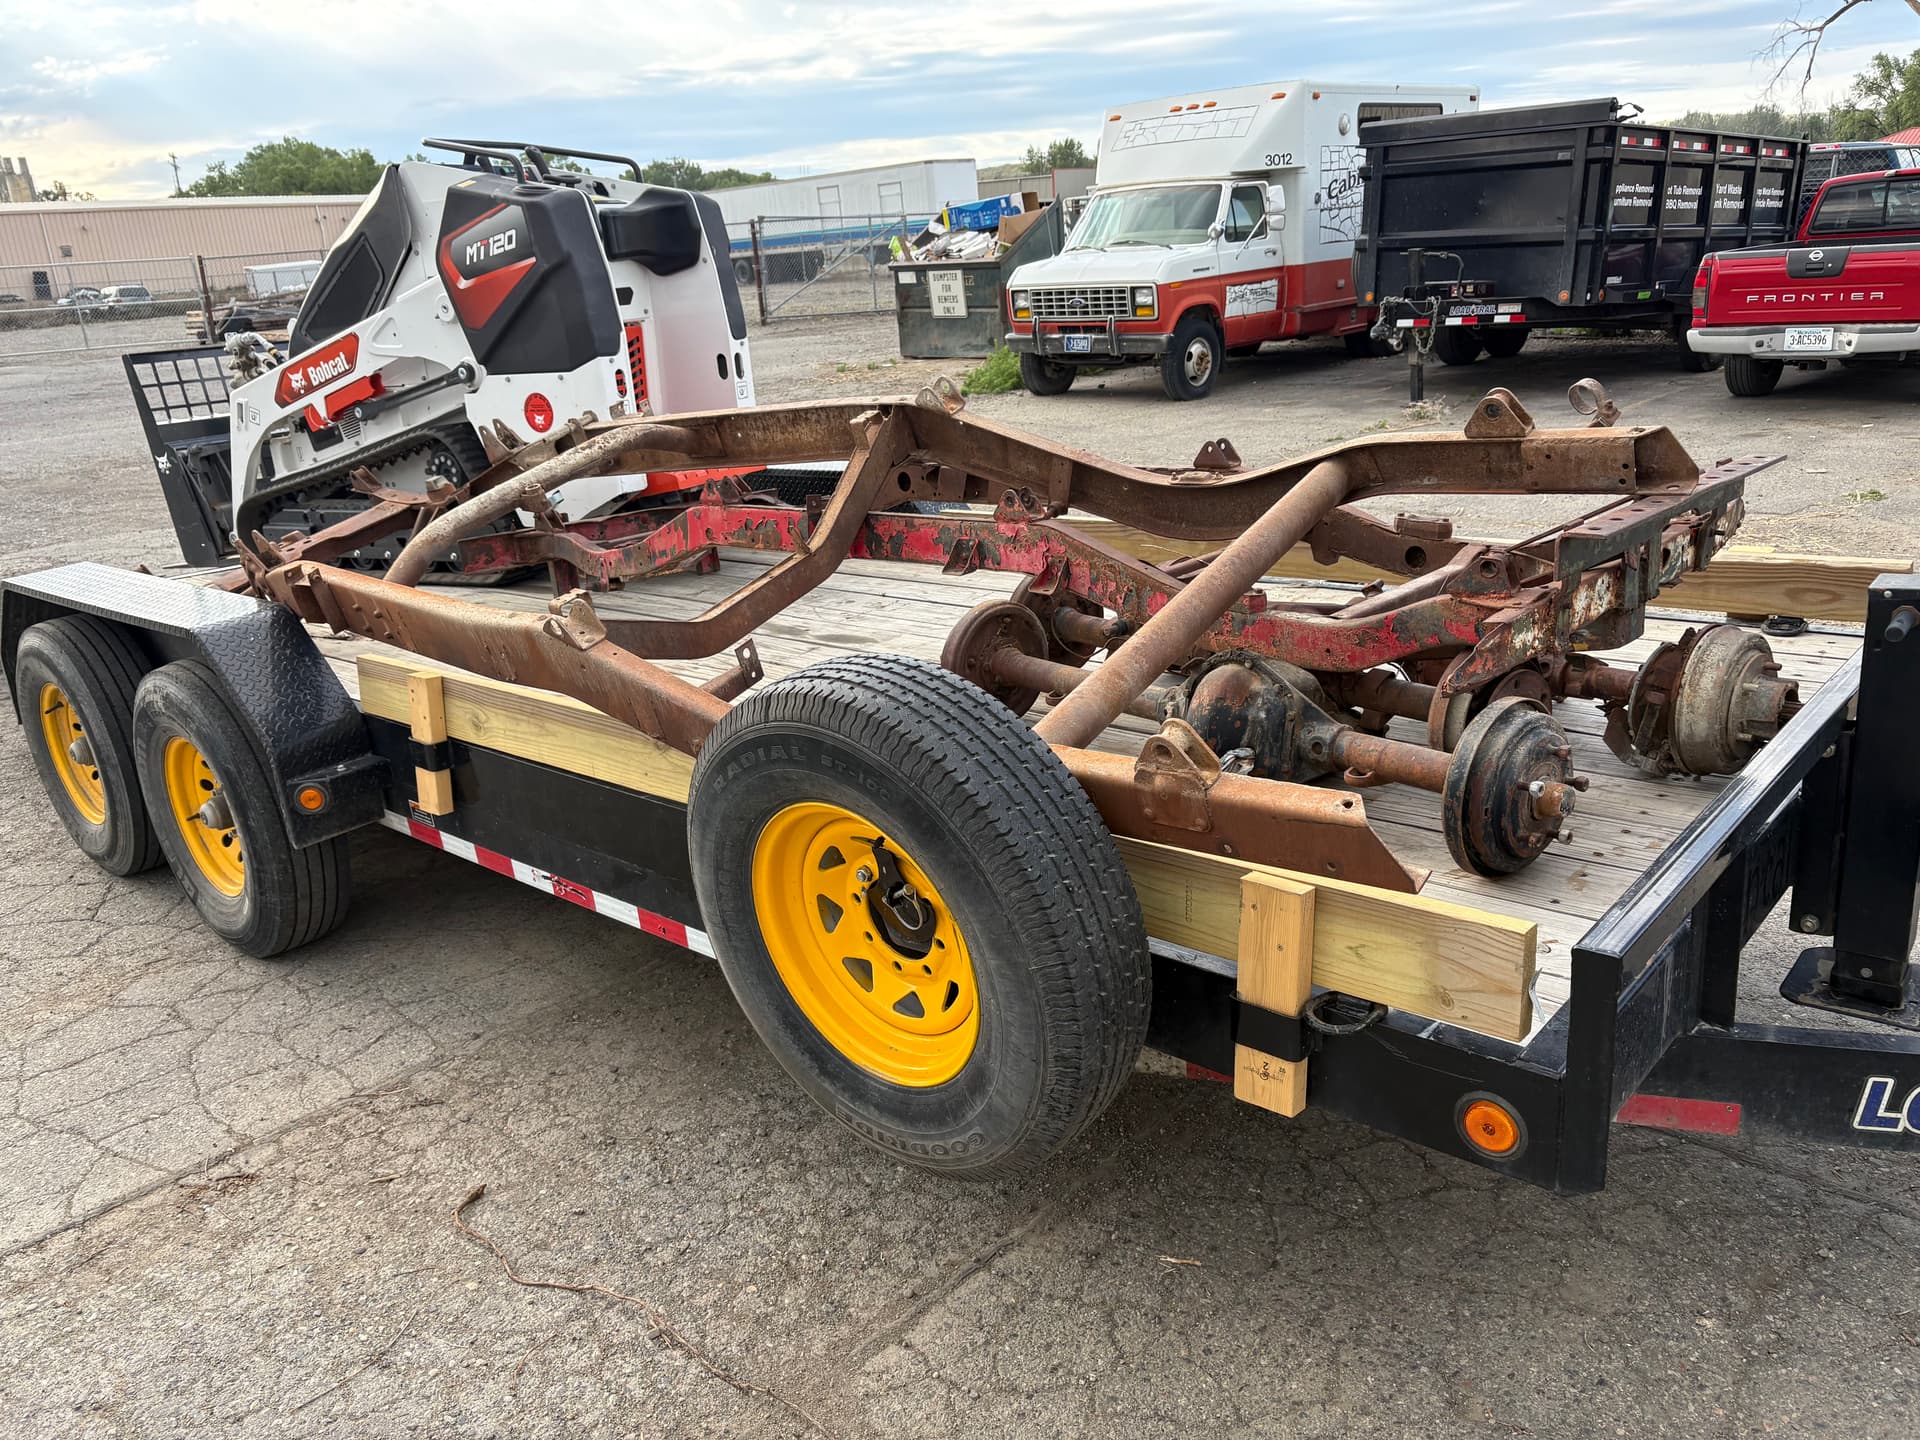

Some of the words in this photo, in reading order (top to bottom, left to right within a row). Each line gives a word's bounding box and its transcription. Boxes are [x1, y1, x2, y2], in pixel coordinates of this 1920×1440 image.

[1264, 152, 1293, 167] 3012
[1327, 170, 1366, 200] Cabi
[1615, 183, 1635, 194] ppliance
[1635, 183, 1655, 193] Removal
[1673, 184, 1682, 195] Tub
[1682, 185, 1703, 196] Removal
[1716, 183, 1728, 195] Yard
[1727, 183, 1743, 195] Waste
[1613, 196, 1632, 207] urniture
[1632, 196, 1653, 207] Removal
[1677, 199, 1699, 209] Removal
[1722, 198, 1745, 209] Removal
[1766, 198, 1784, 208] Removal
[466, 229, 516, 265] MT120
[933, 272, 958, 282] DUMPSTER
[941, 284, 952, 293] FOR
[1746, 291, 1885, 304] FRONTIER
[943, 306, 956, 315] ONLY
[1449, 305, 1472, 316] LOAD
[1474, 304, 1497, 315] TRAIL
[307, 352, 349, 387] Bobcat
[712, 745, 807, 794] RADIAL
